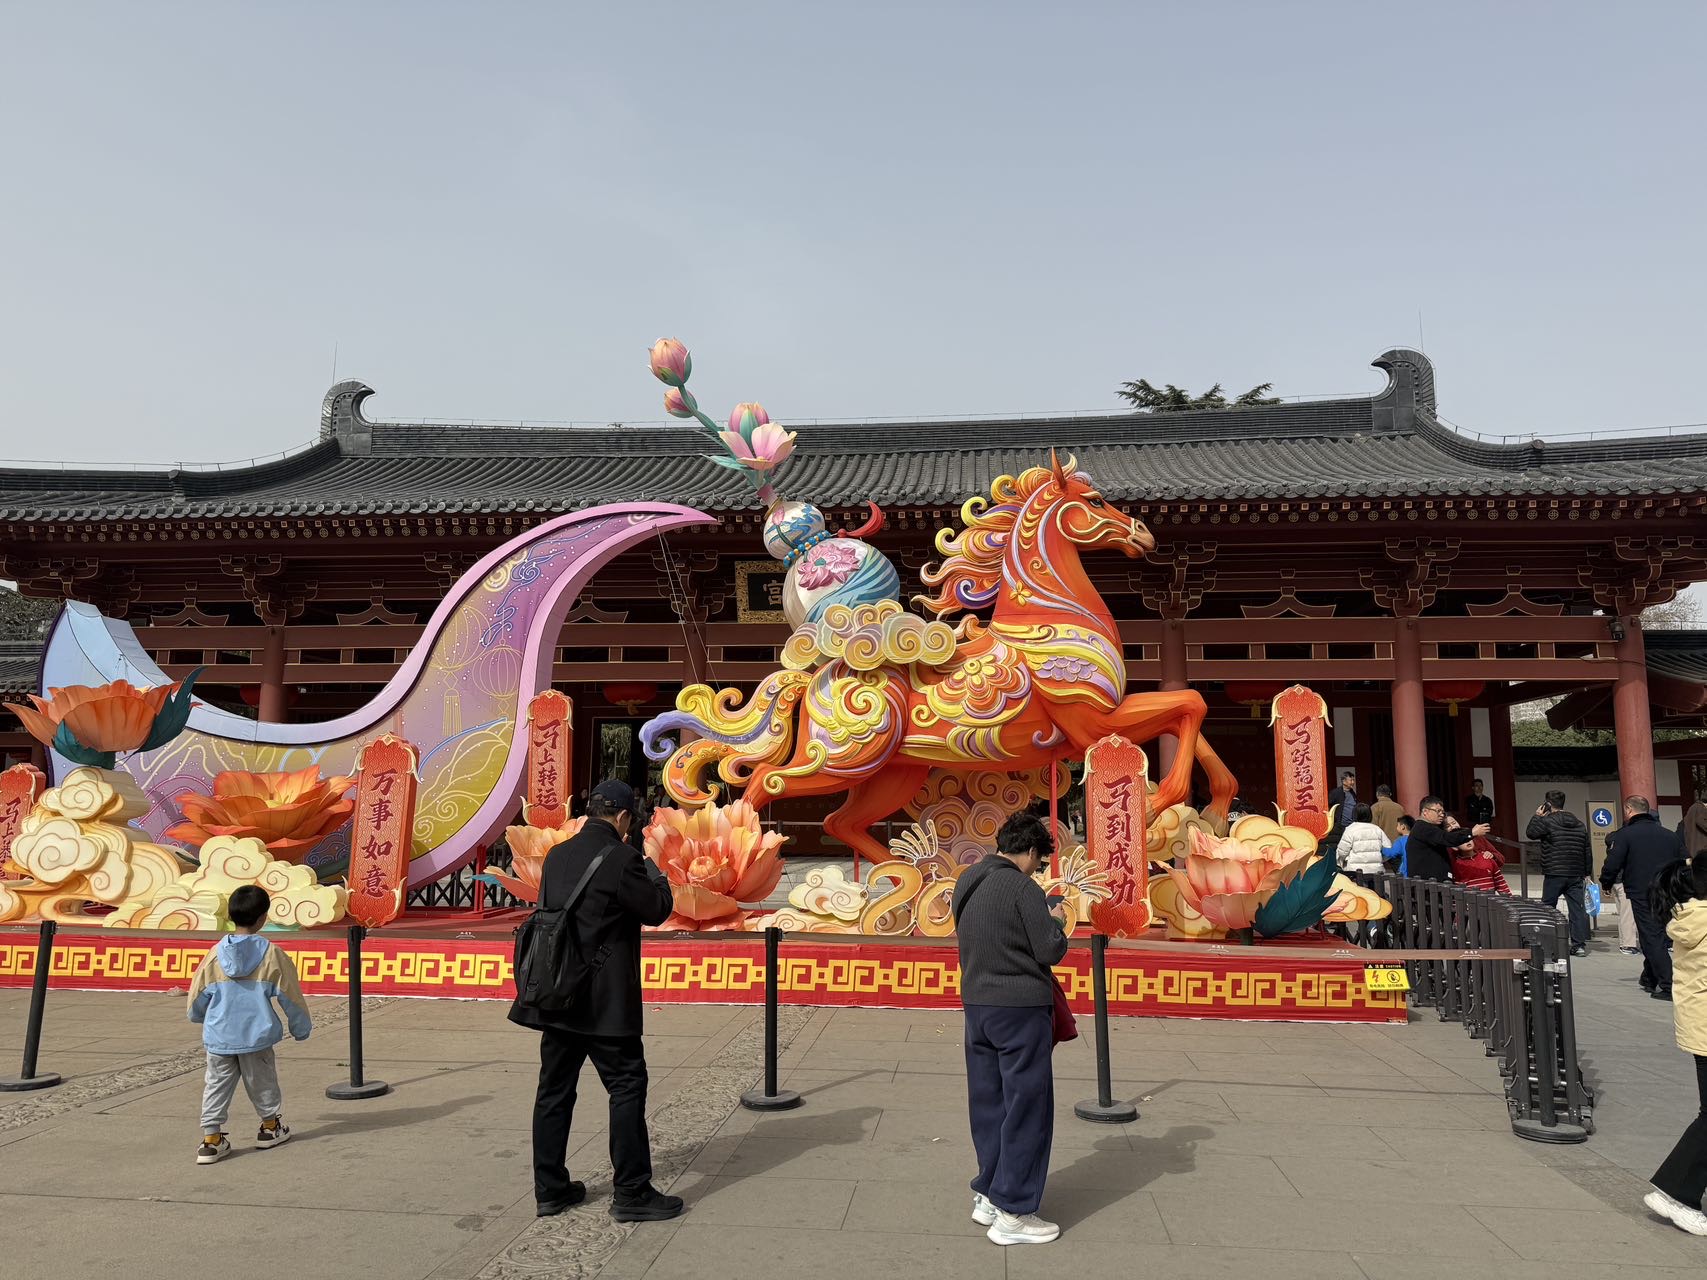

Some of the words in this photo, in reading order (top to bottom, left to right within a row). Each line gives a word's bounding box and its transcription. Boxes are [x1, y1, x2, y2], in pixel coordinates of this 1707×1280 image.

[533, 718, 561, 811] 马上转运
[360, 768, 398, 898] 万事如意
[1099, 774, 1136, 907] 马到成功
